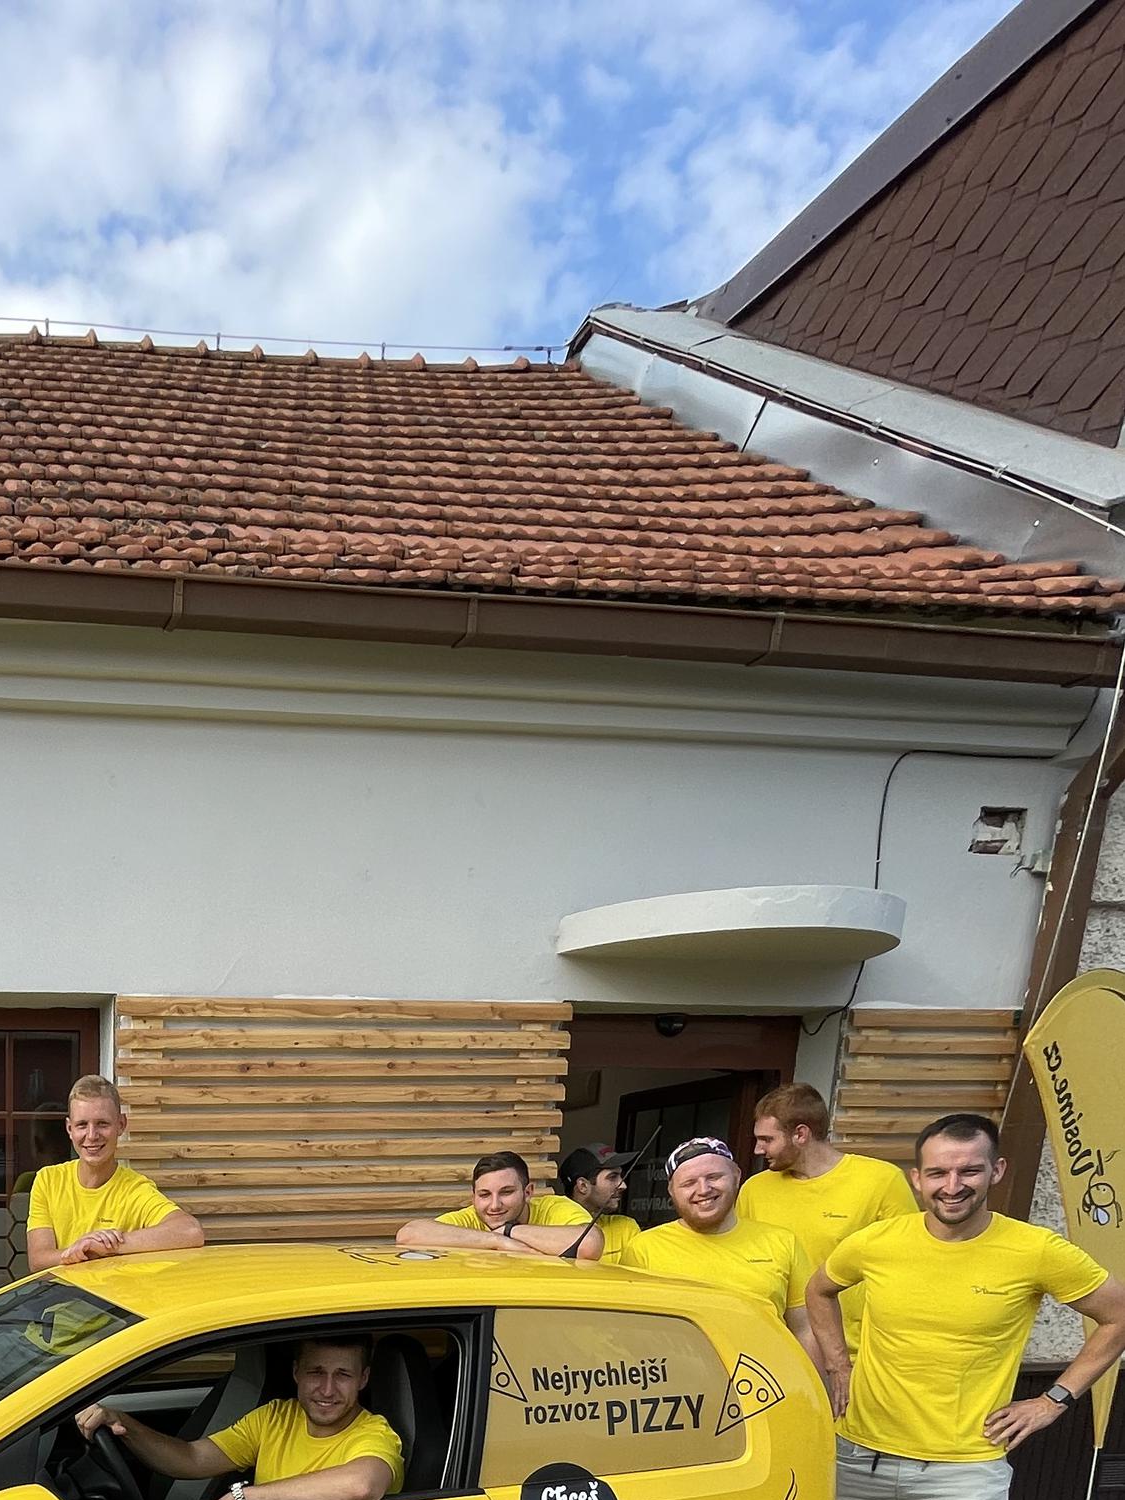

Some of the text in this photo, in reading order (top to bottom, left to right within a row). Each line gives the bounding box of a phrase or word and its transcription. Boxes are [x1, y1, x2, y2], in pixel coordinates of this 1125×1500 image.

[531, 1358, 668, 1395] Nejrychlejší
[524, 1394, 704, 1435] rozvoz PIZZY
